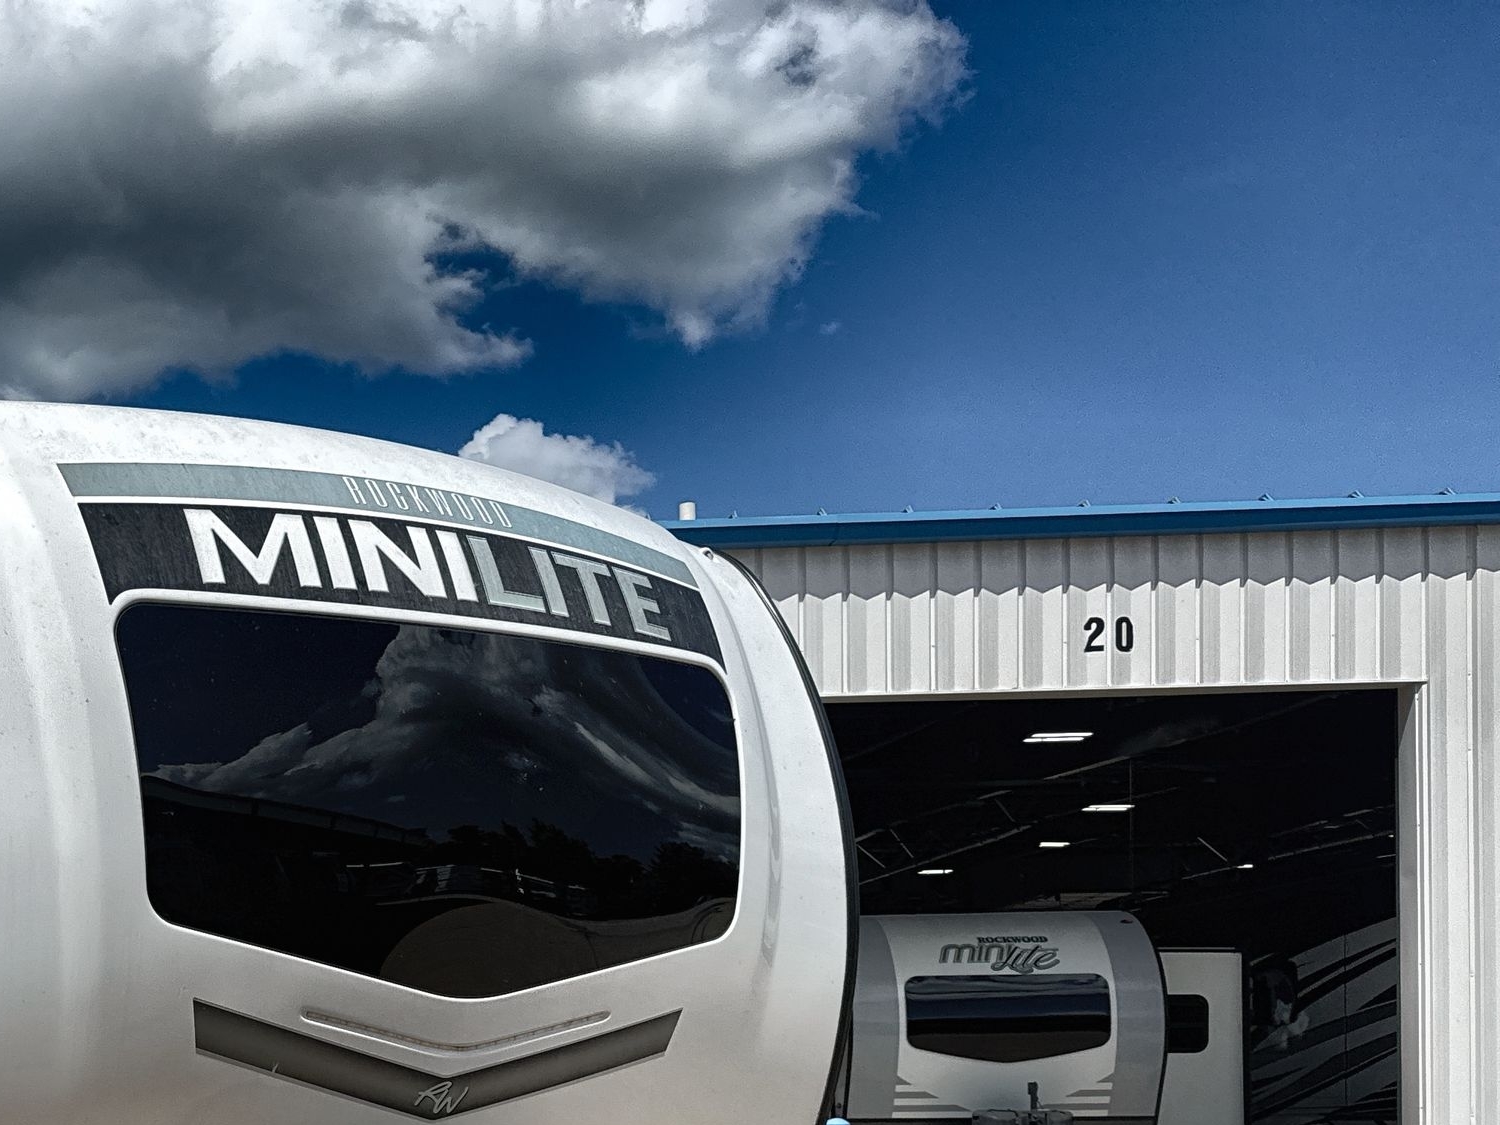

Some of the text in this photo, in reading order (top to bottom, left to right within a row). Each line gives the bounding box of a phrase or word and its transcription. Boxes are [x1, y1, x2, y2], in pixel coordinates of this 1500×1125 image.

[342, 476, 513, 528] ROCKWOOD
[183, 508, 672, 641] MINILITE
[1083, 616, 1134, 653] 20
[976, 935, 1048, 943] ROCKWOOD
